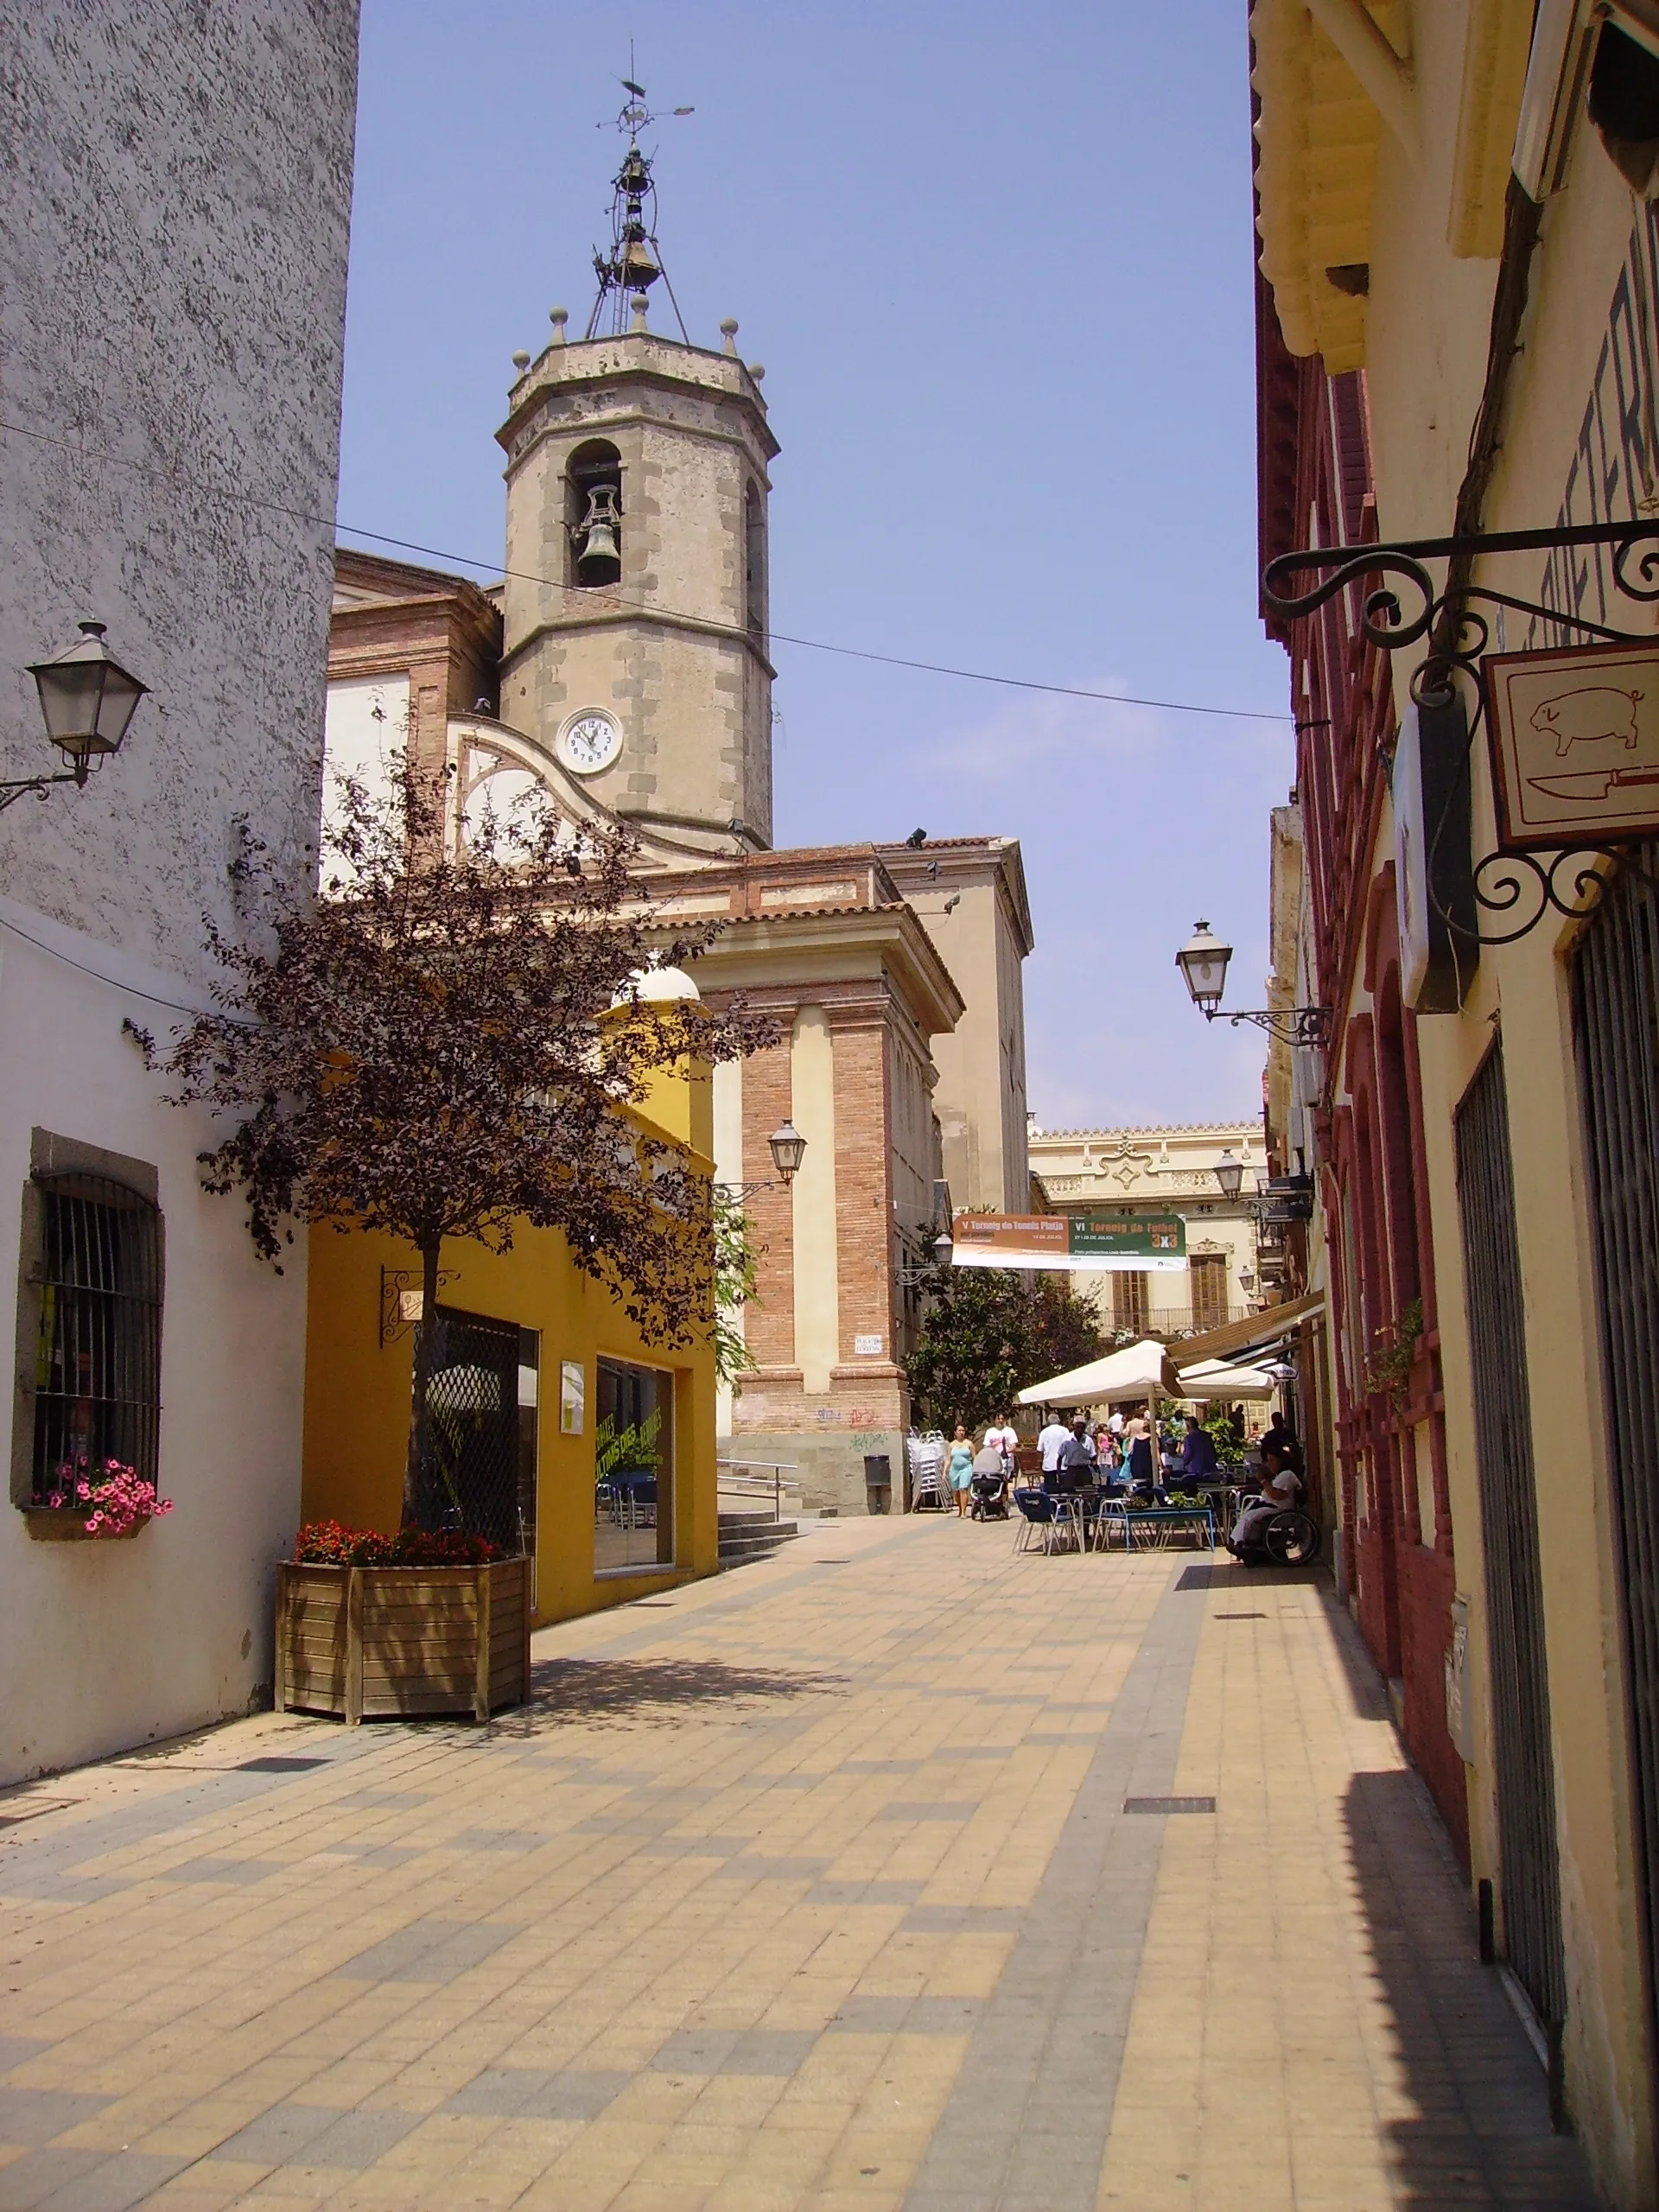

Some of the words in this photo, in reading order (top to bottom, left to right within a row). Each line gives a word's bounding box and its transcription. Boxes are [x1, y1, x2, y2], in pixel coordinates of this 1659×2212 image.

[971, 1222, 1000, 1230] Torneig
[1075, 1222, 1085, 1231] VI
[1090, 1223, 1127, 1233] Torneig
[1131, 1223, 1143, 1232] de
[1147, 1223, 1177, 1232] Futbol
[1151, 1234, 1178, 1248] 3x3
